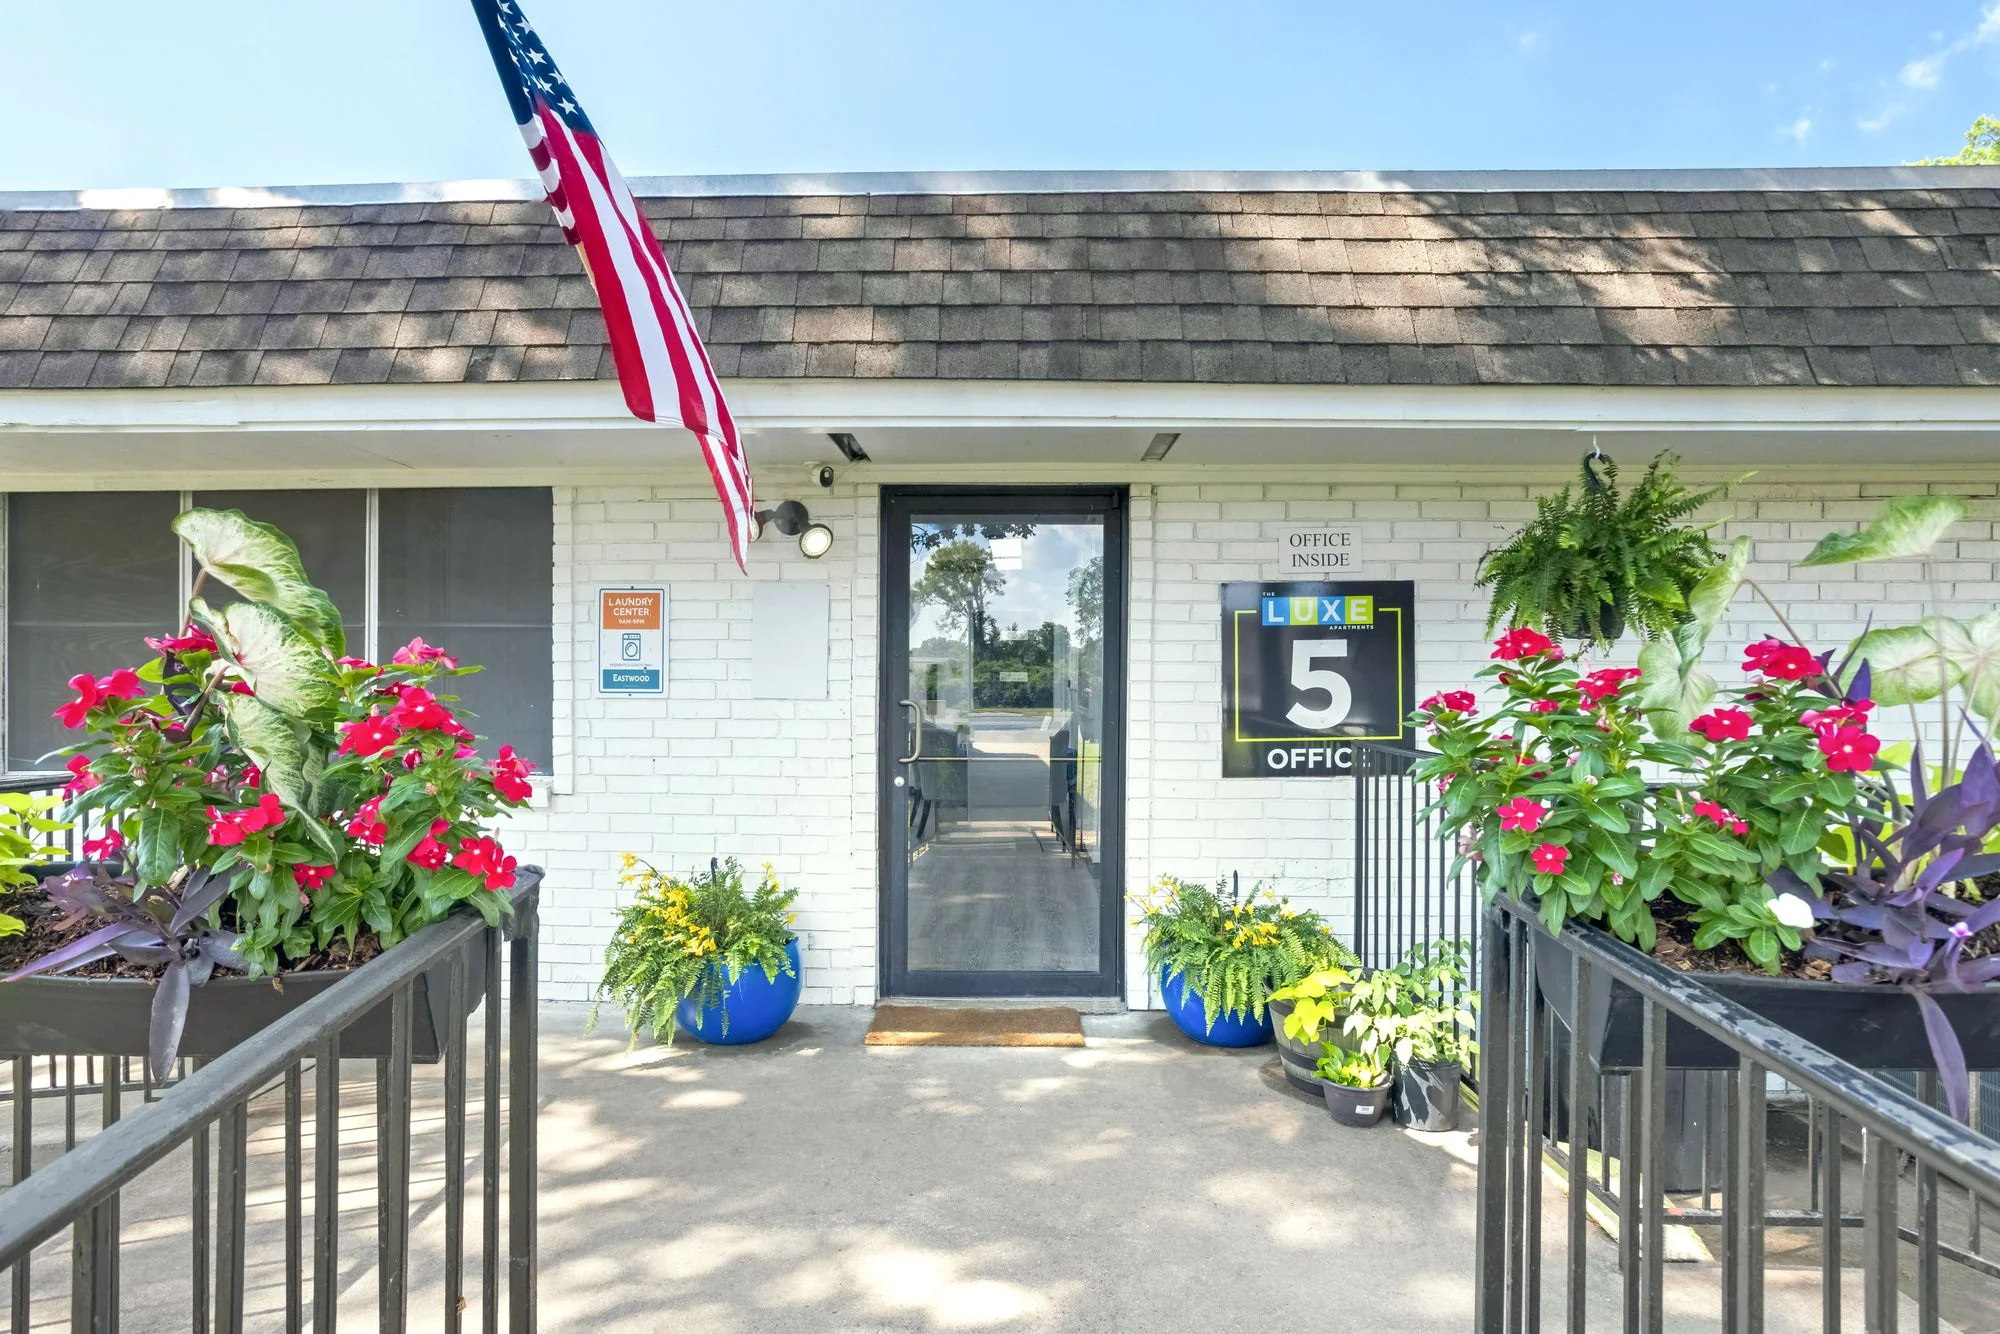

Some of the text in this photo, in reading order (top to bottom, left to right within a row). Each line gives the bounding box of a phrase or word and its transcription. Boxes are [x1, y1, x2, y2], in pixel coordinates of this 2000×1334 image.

[1289, 533, 1351, 547] OFFICE
[1292, 553, 1350, 568] INSIDE
[608, 597, 654, 606] LAUNDRY
[613, 608, 650, 616] CENTER
[1268, 599, 1368, 623] LUXE
[1285, 638, 1352, 730] 5
